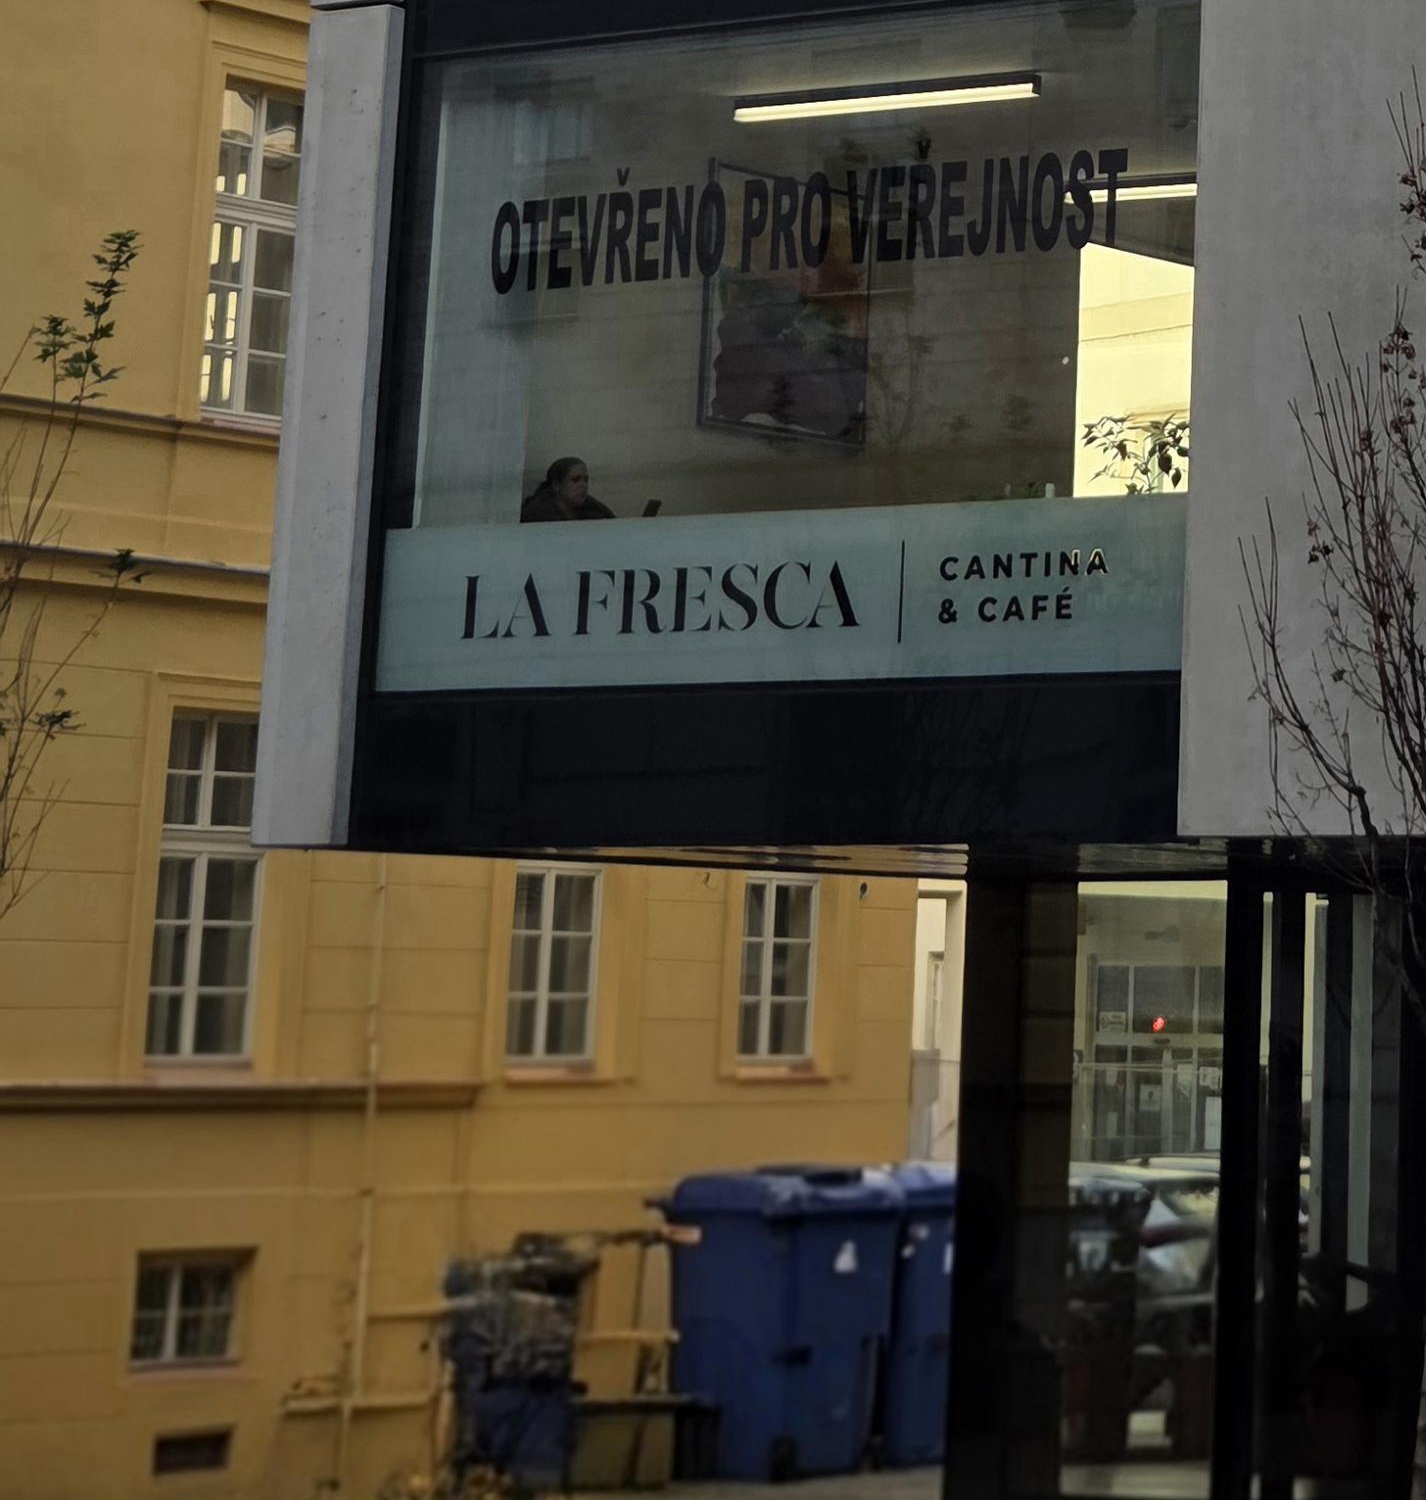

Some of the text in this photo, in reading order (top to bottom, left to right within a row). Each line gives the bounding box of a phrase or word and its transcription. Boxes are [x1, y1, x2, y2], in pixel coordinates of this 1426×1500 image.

[491, 139, 1129, 295] OTEVŘENO PRO VEŘEJNOST
[938, 548, 1110, 583] CANTINA
[461, 560, 860, 641] LA FRESCA
[937, 586, 1074, 625] & CAFÉ
